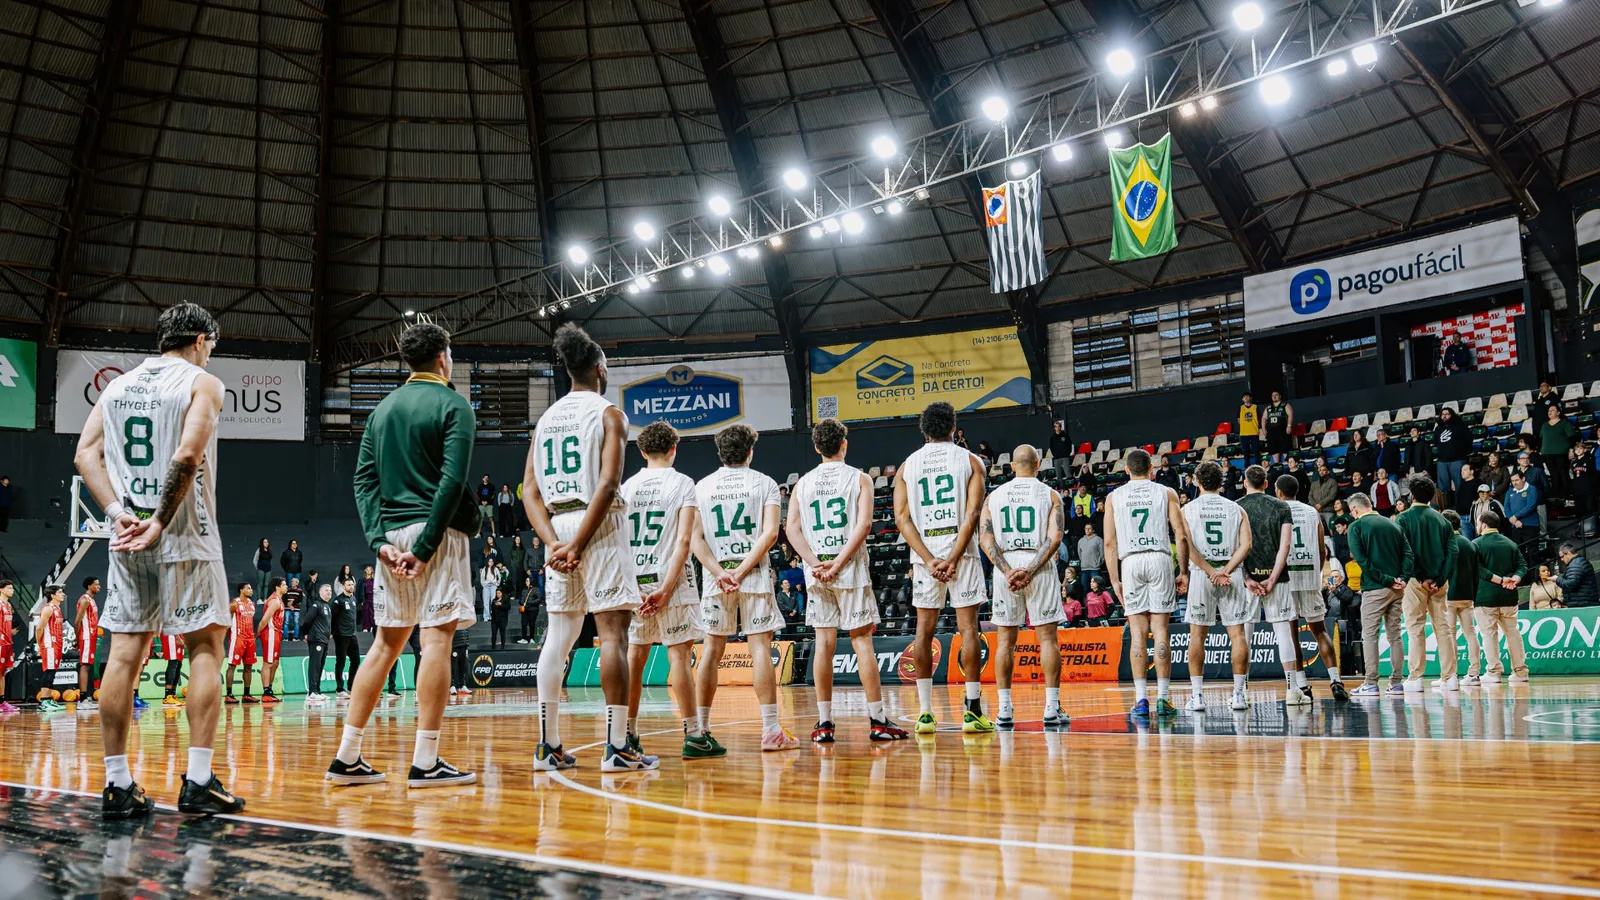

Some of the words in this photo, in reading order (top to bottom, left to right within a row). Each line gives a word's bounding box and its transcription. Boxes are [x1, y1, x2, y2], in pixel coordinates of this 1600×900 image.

[1338, 244, 1465, 301] pagoufácil
[972, 336, 985, 346] (14)
[921, 362, 932, 370] Na
[934, 359, 971, 369] Concreto
[241, 374, 282, 388] grupo
[938, 369, 966, 378] imóvel
[922, 379, 939, 392] DÁ
[942, 376, 984, 390] CERTO!
[857, 387, 916, 400] CONCRETO
[633, 392, 731, 415] MEZZANI
[238, 415, 282, 424] SOLUÇÕES
[124, 416, 154, 467] 8
[543, 435, 581, 476] 16
[922, 466, 948, 474] BORGES
[711, 492, 750, 501] MICHELINI
[918, 473, 955, 507] 12
[711, 502, 757, 538] 14
[809, 497, 848, 531] 13
[1001, 505, 1036, 533] 10
[1132, 508, 1150, 533] 7
[628, 510, 666, 547] 15
[1205, 521, 1223, 545] 5
[1292, 526, 1305, 548] 1
[186, 603, 209, 616] SPSP
[435, 601, 455, 612] SPSP
[1060, 643, 1107, 652] PAULISTA
[1525, 649, 1588, 660] COMÉRCIO
[474, 666, 492, 674] FPB
